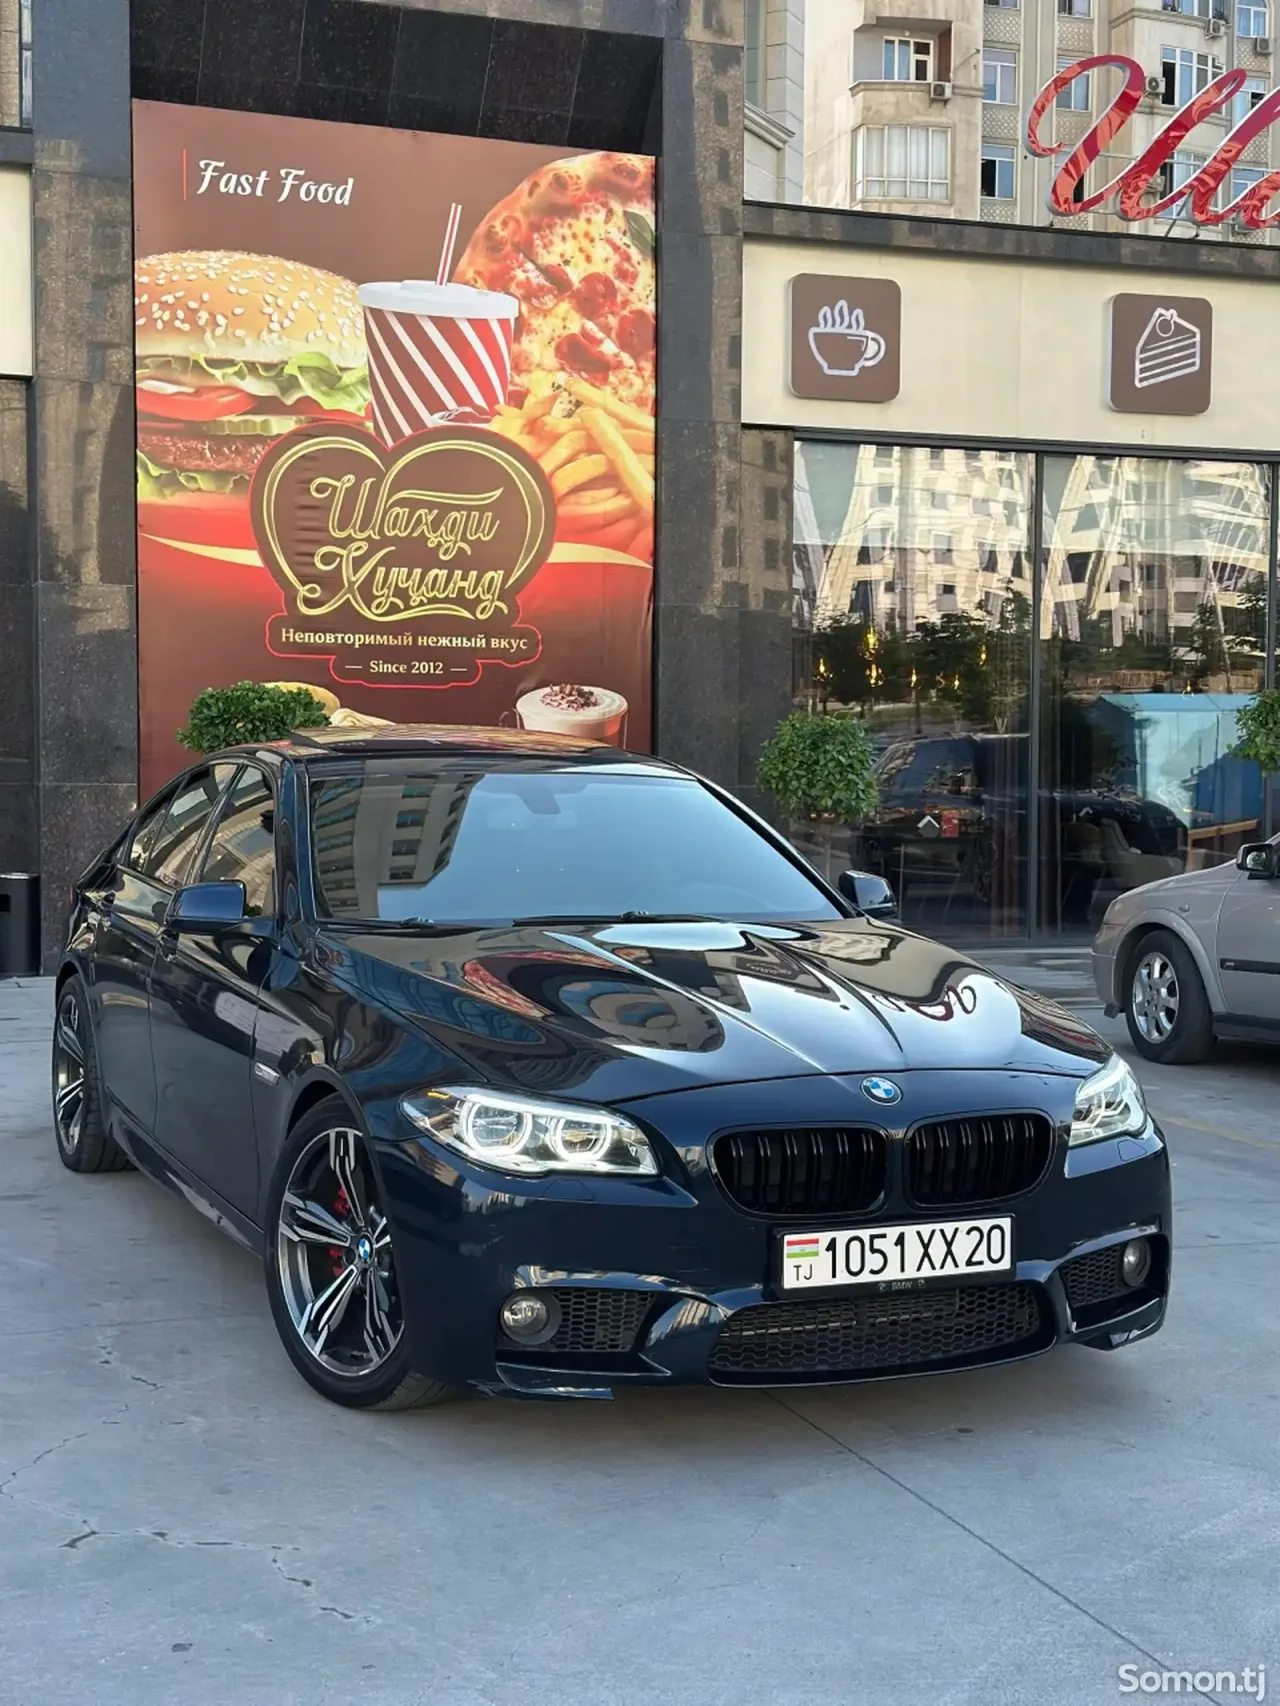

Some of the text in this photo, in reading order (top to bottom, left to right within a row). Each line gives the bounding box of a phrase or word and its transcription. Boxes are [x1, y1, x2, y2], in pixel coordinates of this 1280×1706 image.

[197, 159, 354, 206] Fast Food
[281, 628, 528, 650] Неповторимый нежный вкус
[369, 660, 444, 674] Since 2012
[793, 1224, 1006, 1282] TJ 1051XX20
